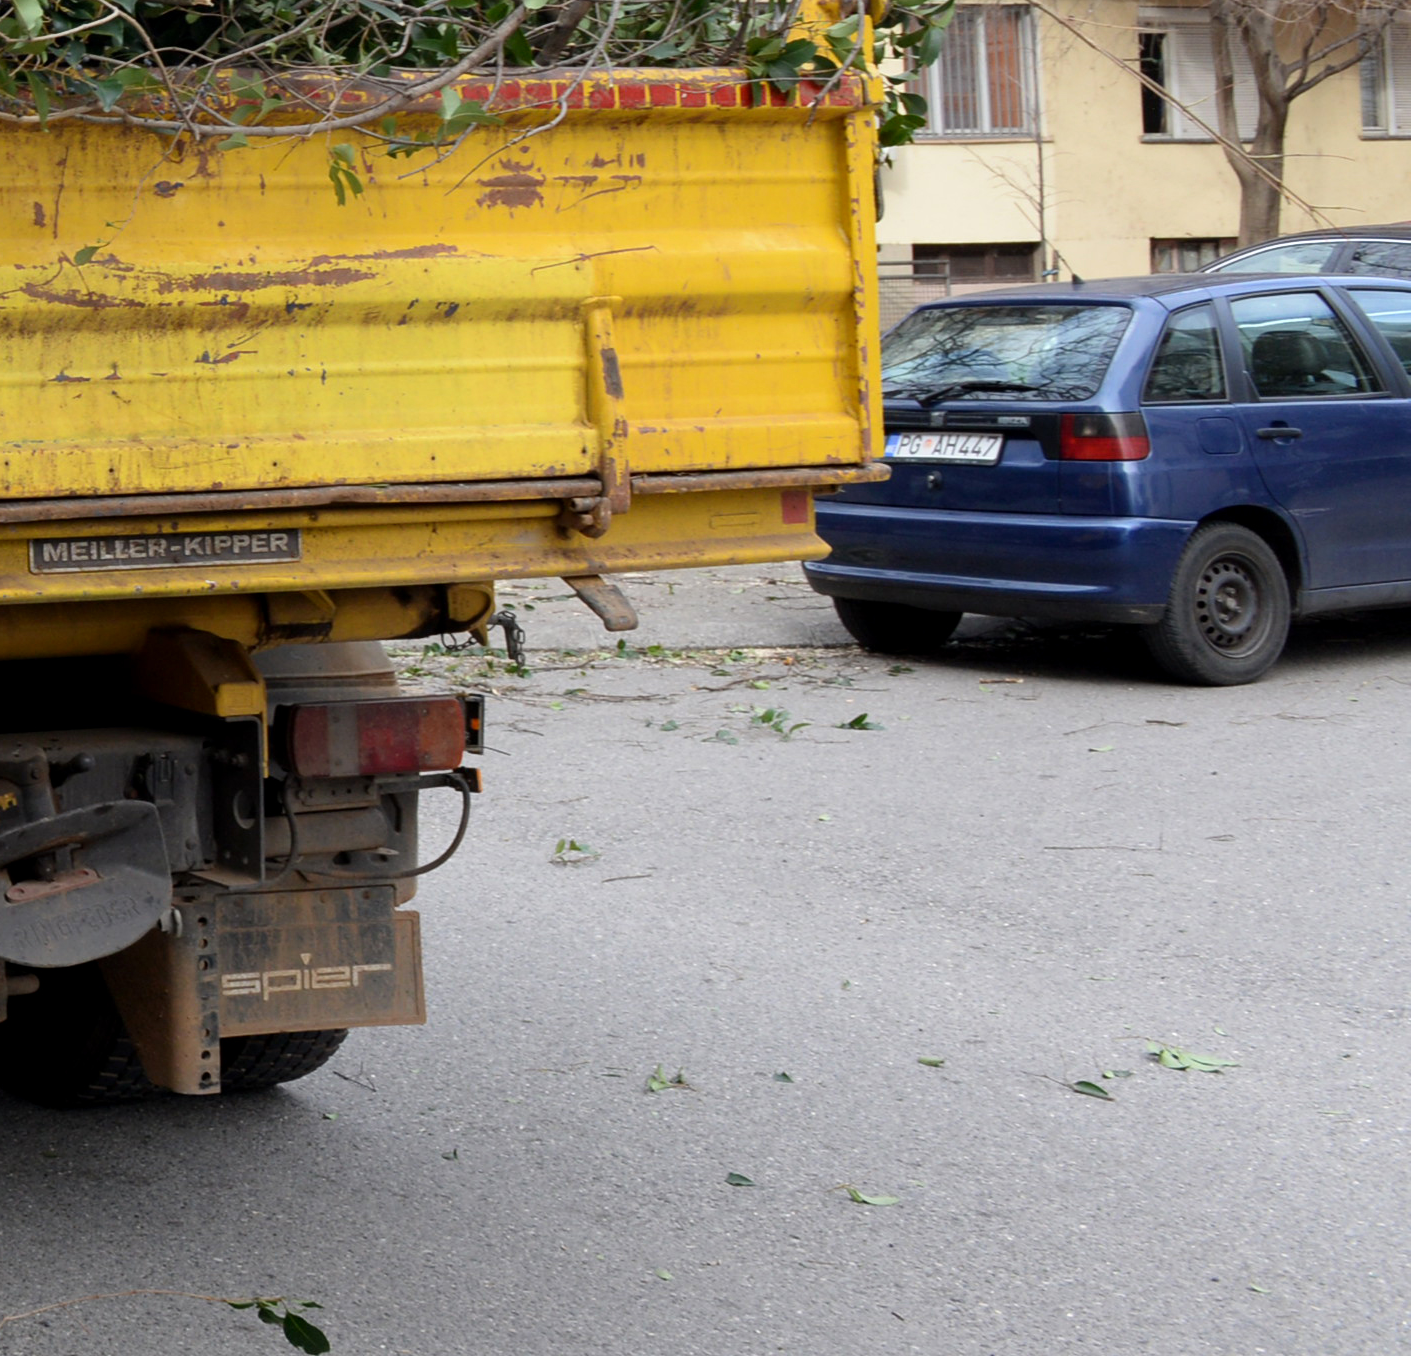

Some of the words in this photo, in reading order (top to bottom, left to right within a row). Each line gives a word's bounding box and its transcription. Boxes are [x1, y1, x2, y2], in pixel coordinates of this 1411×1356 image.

[897, 434, 922, 456] PG
[42, 533, 289, 563] MEILLER-KIPPER
[221, 952, 392, 1001] spier
